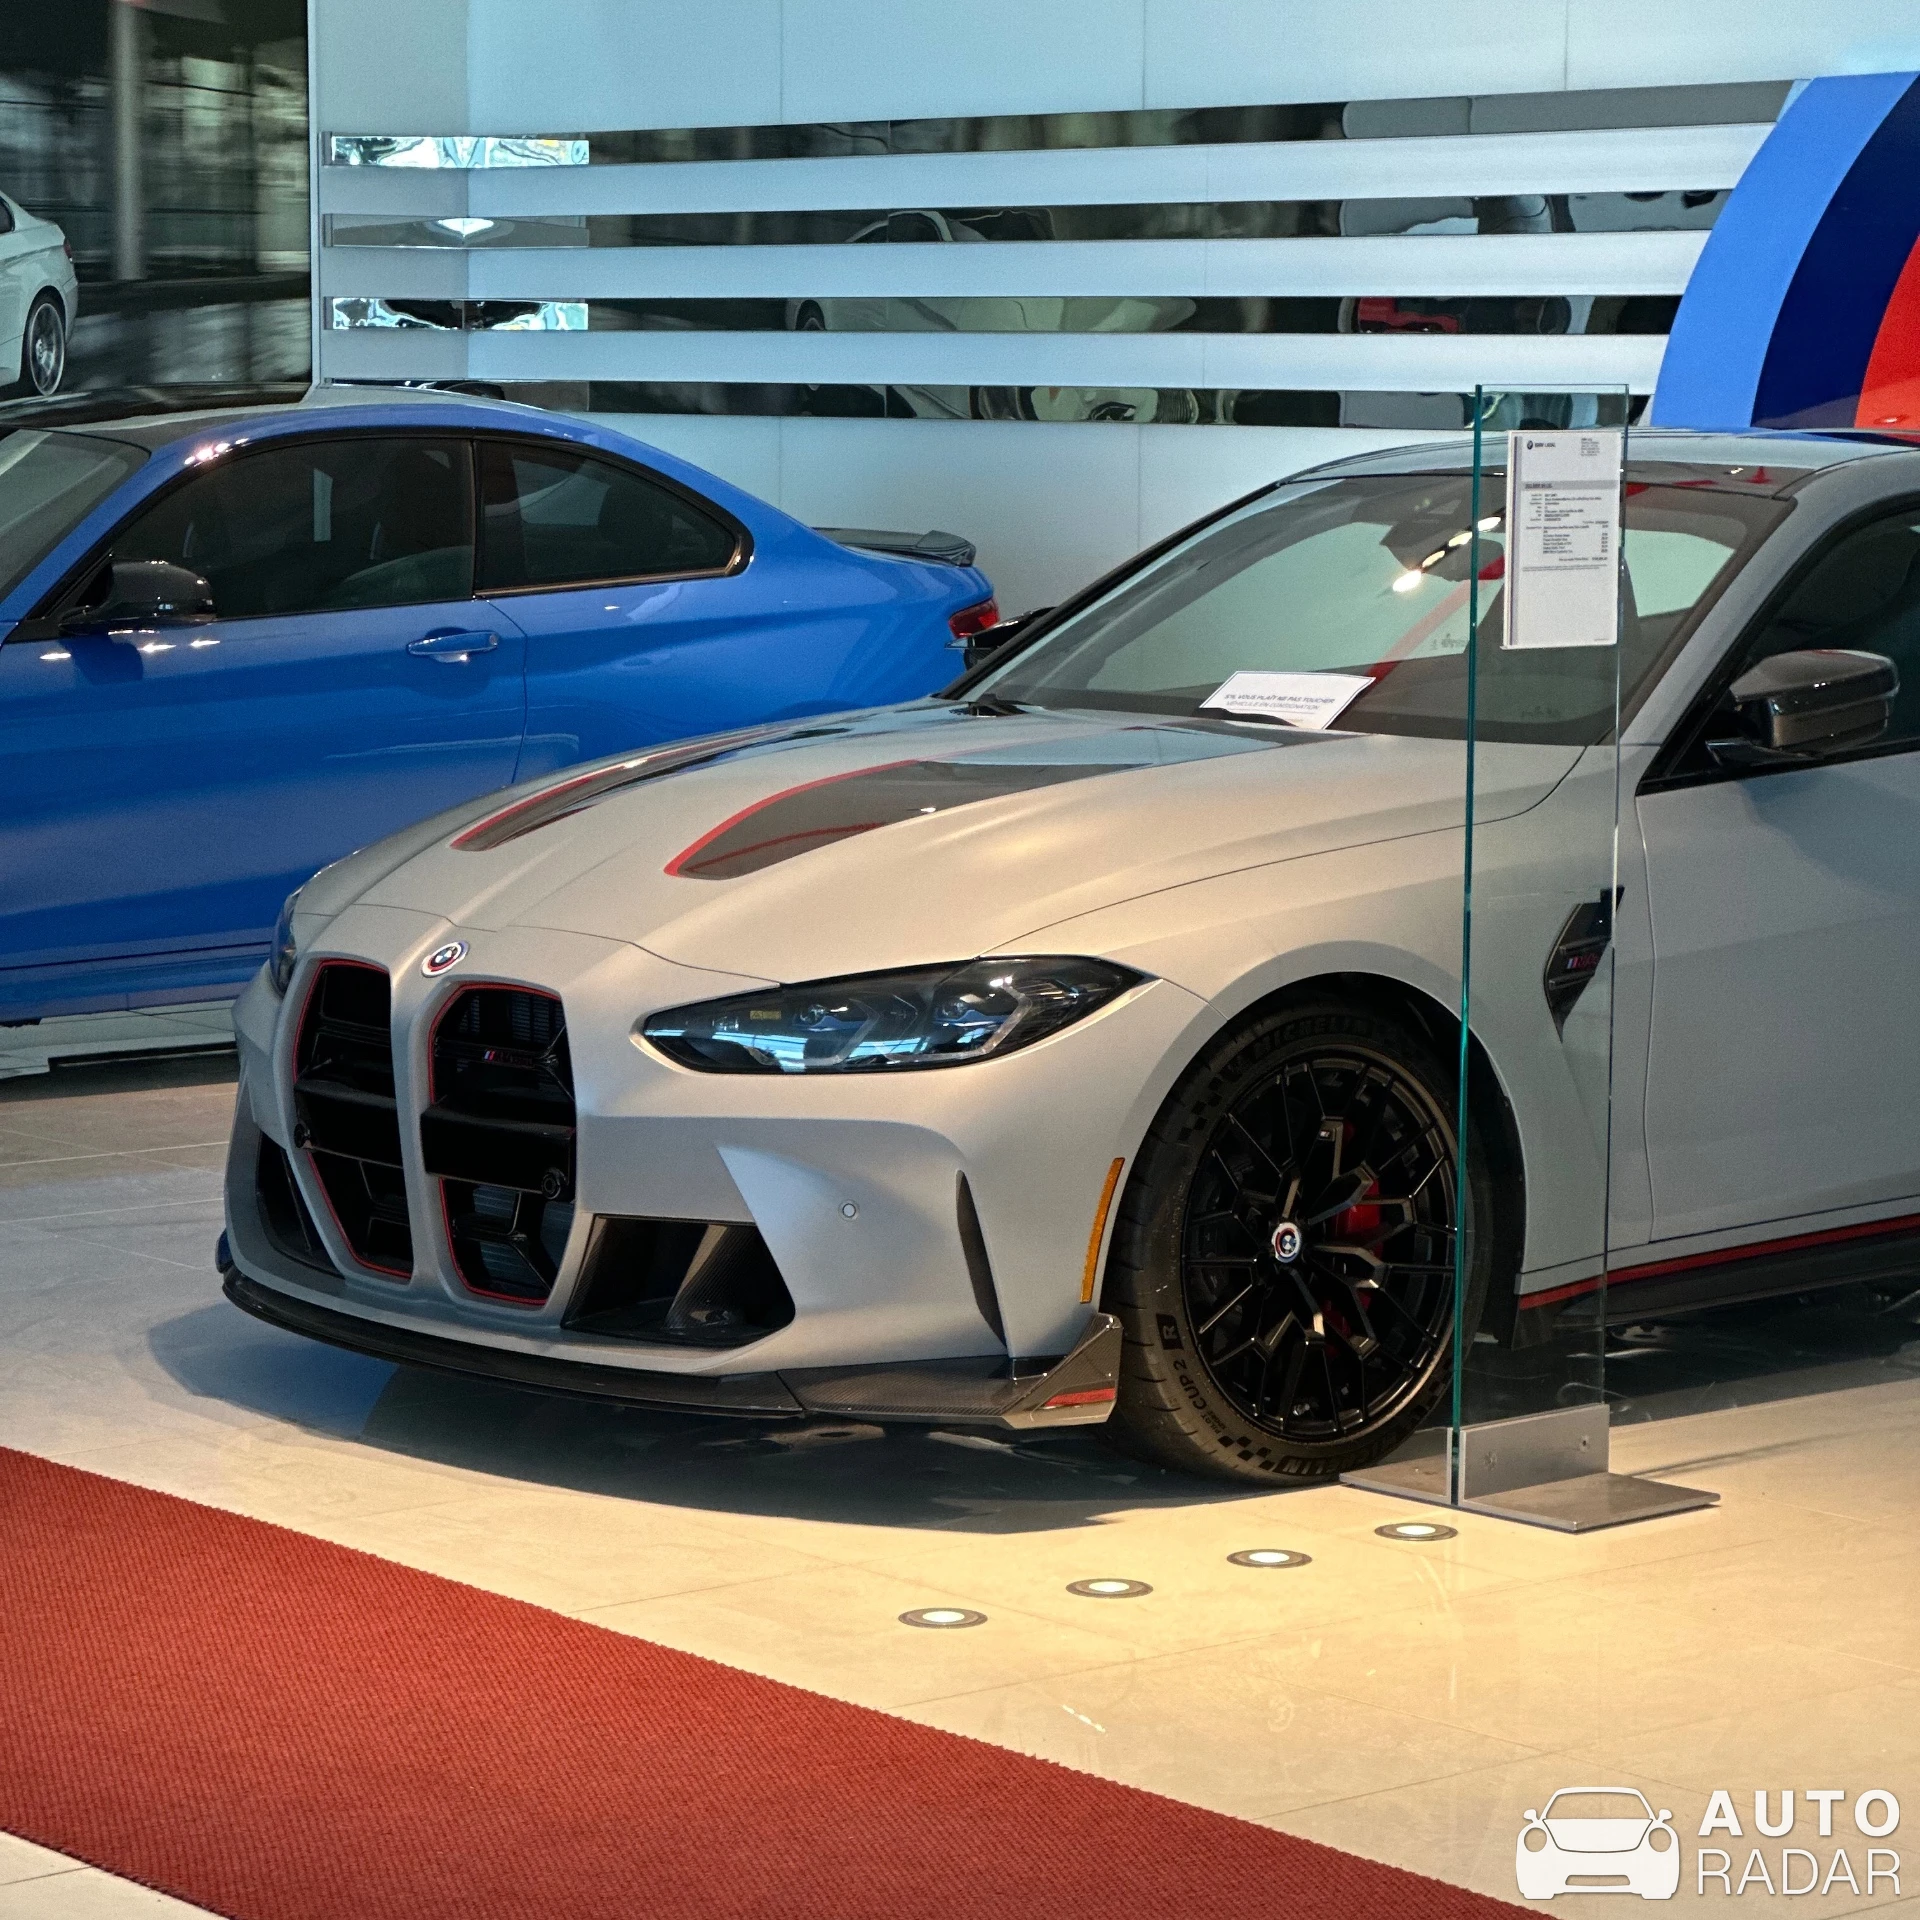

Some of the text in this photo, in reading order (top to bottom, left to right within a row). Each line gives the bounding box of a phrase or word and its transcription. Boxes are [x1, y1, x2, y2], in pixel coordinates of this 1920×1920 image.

[1162, 1325, 1178, 1340] R
[1173, 1358, 1207, 1410] CUP 2
